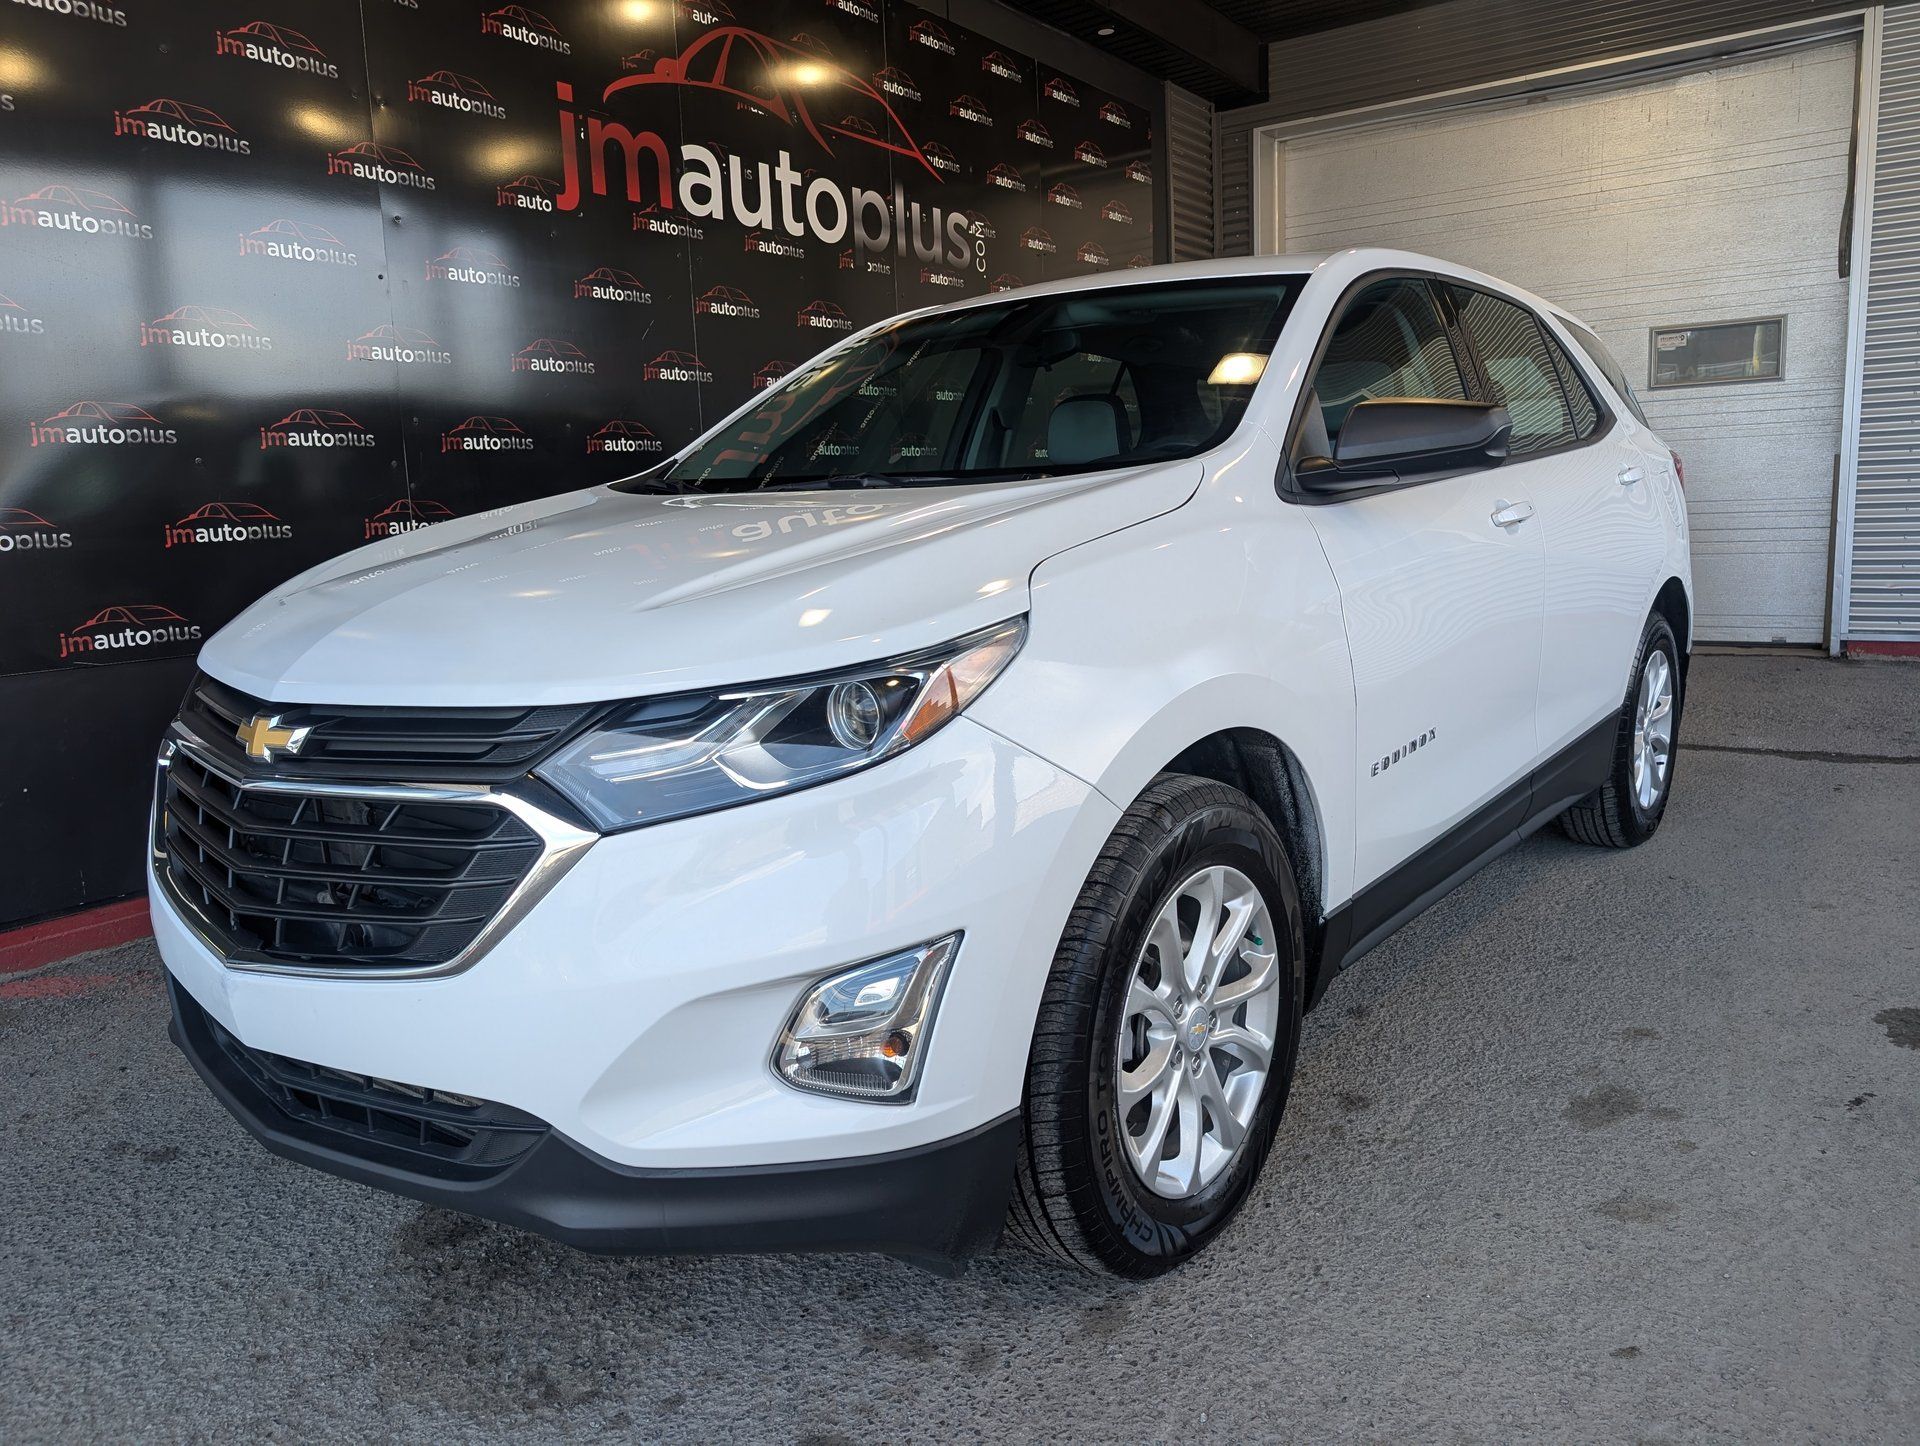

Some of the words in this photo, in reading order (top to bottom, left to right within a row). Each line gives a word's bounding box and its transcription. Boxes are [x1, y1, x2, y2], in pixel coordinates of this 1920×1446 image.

[481, 12, 571, 55] jmautoplus
[909, 25, 956, 56] jmautoplus
[216, 30, 339, 79] jmautoplus
[407, 80, 506, 120] jmautoplus
[873, 73, 922, 102] jmautoplus
[950, 101, 993, 127] jmautoplus
[113, 111, 251, 156] jmautoplus
[327, 152, 436, 191] jmautoplus
[556, 80, 972, 271] jmautoplus
[0, 203, 154, 241] jmautoplus
[632, 212, 704, 240] jmautoplus
[239, 233, 358, 267] jmautoplus
[744, 234, 805, 259] jmautoplus
[425, 259, 520, 288] jmautoplus
[574, 280, 652, 305] jmautoplus
[696, 297, 761, 320] jmautoplus
[797, 311, 853, 331] jmautoplus
[140, 321, 273, 352] jmautoplus
[346, 339, 452, 366] jmautoplus
[511, 353, 595, 375] jmautoplus
[643, 363, 713, 383] jmautoplus
[30, 421, 178, 448] jmautoplus
[260, 427, 376, 451] jmautoplus
[441, 433, 534, 453] jmautoplus
[586, 435, 663, 453] jmautoplus
[165, 523, 293, 549] jmautoplus
[60, 623, 202, 658] jmautoplus
[1370, 726, 1437, 778] EQUINOX
